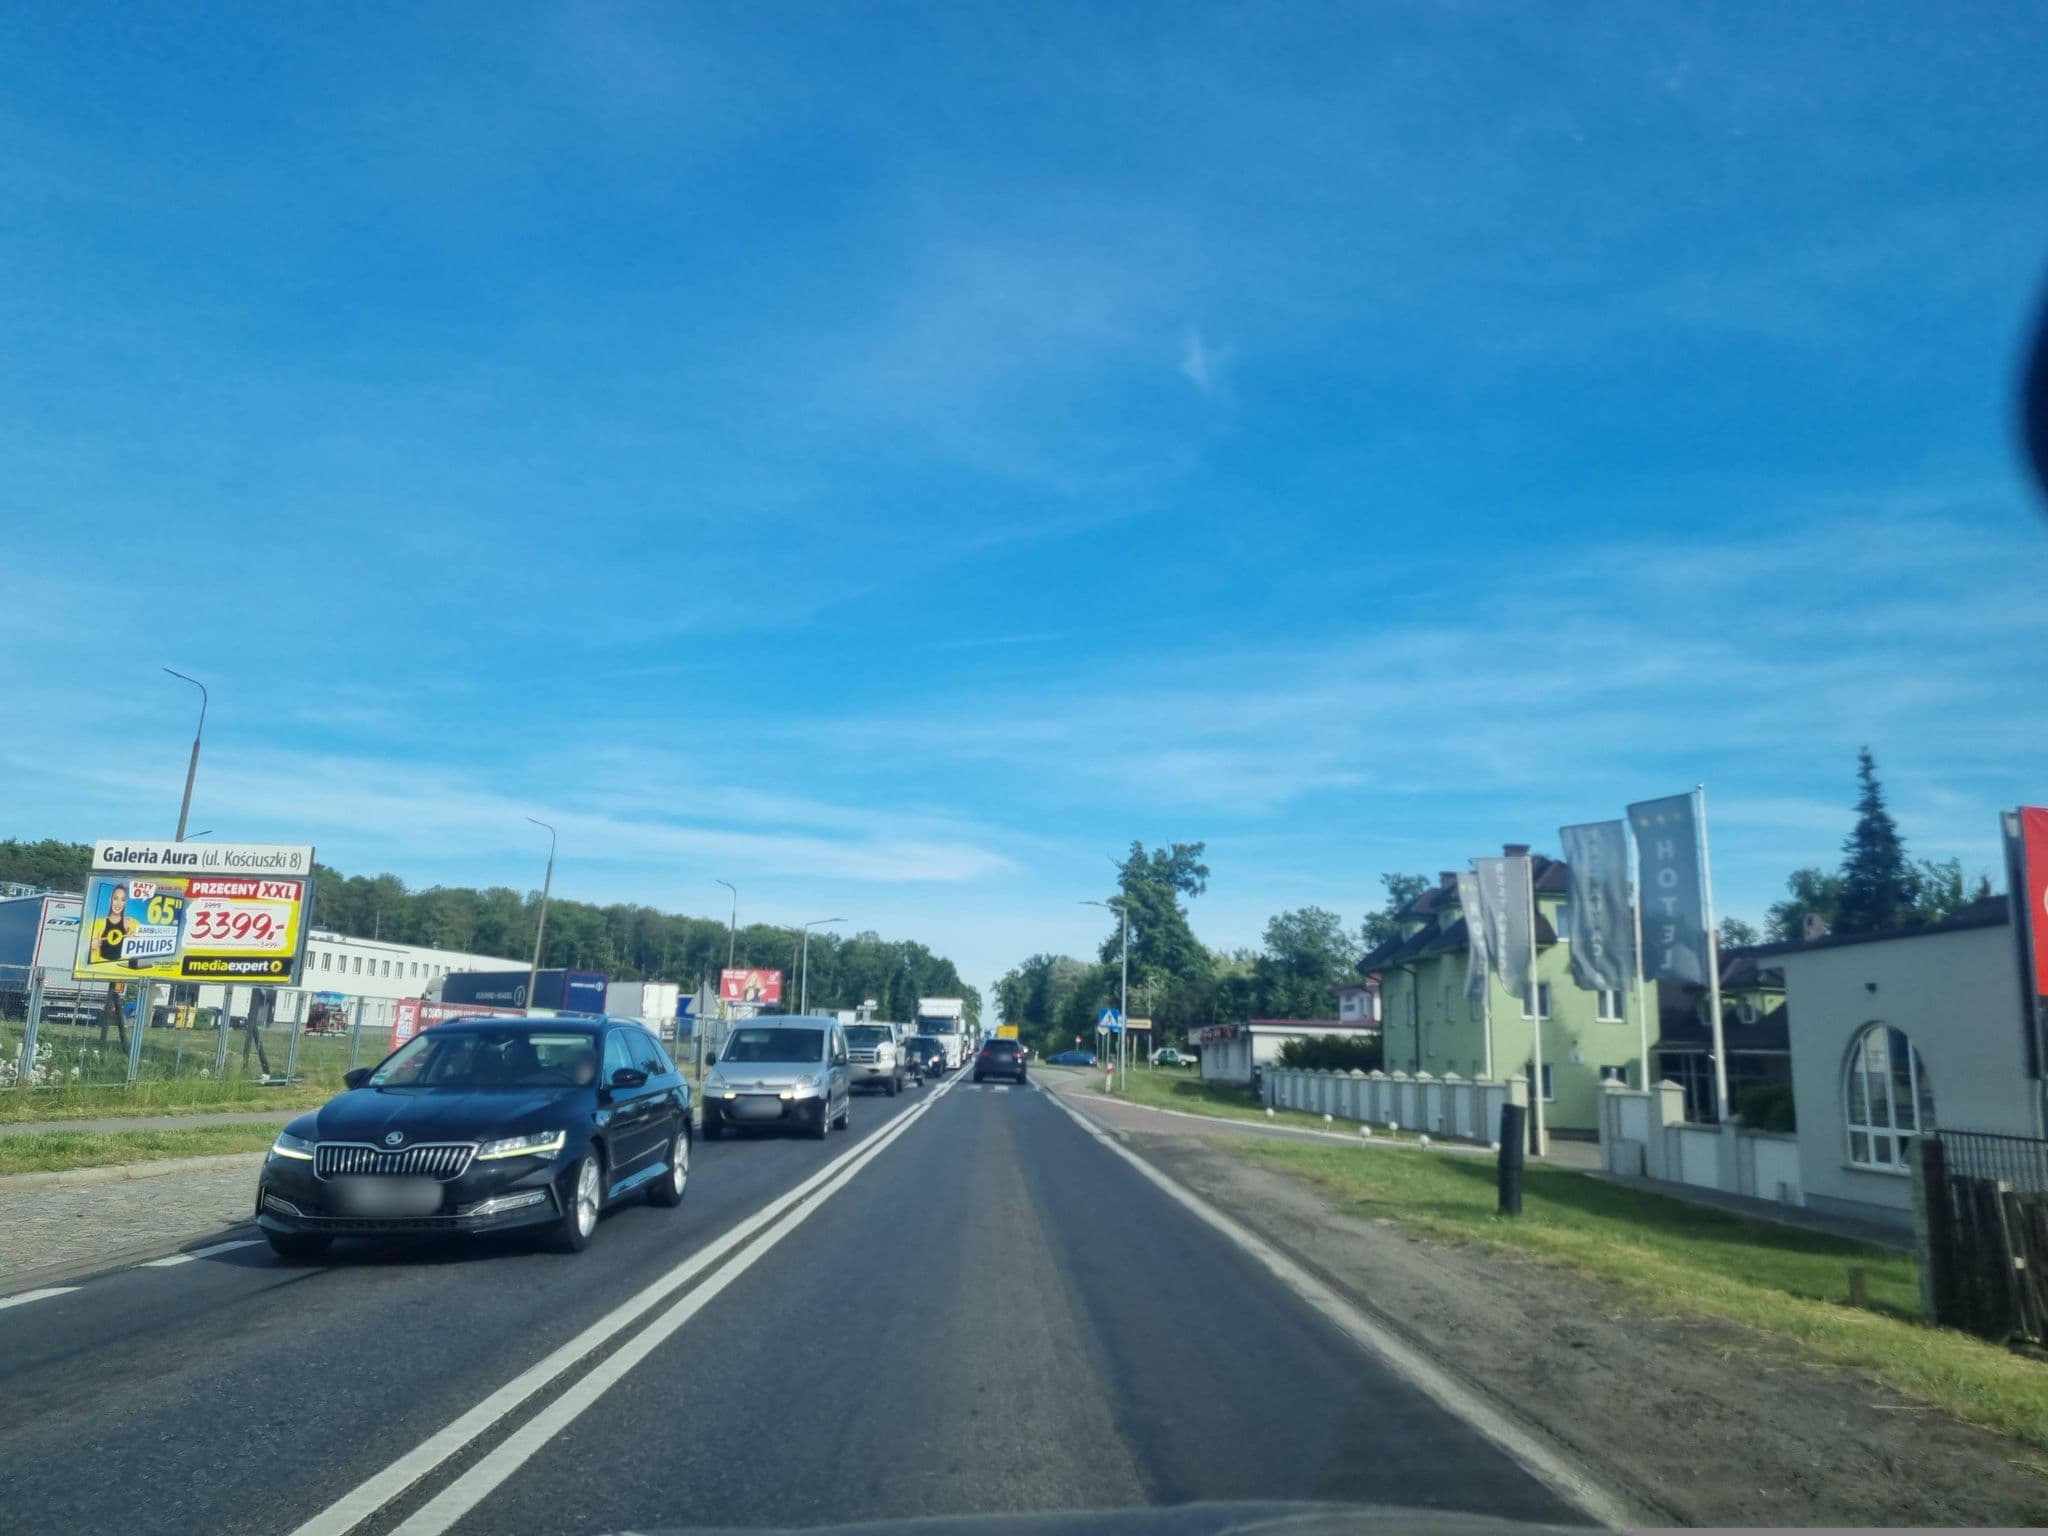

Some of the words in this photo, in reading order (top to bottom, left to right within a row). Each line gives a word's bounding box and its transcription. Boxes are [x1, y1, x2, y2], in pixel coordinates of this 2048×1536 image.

[103, 846, 157, 864] Galeria
[161, 848, 198, 865] Aura
[202, 851, 220, 868] (ul.
[224, 851, 286, 868] Kościuszki
[289, 852, 302, 870] 8)
[133, 882, 153, 890] RATY
[133, 889, 151, 898] 0%
[192, 882, 259, 896] PRZECENY
[262, 882, 292, 899] XXL
[189, 911, 285, 940] 3399,-
[126, 939, 173, 954] PHILIPS
[189, 959, 269, 973] mediaexpert
